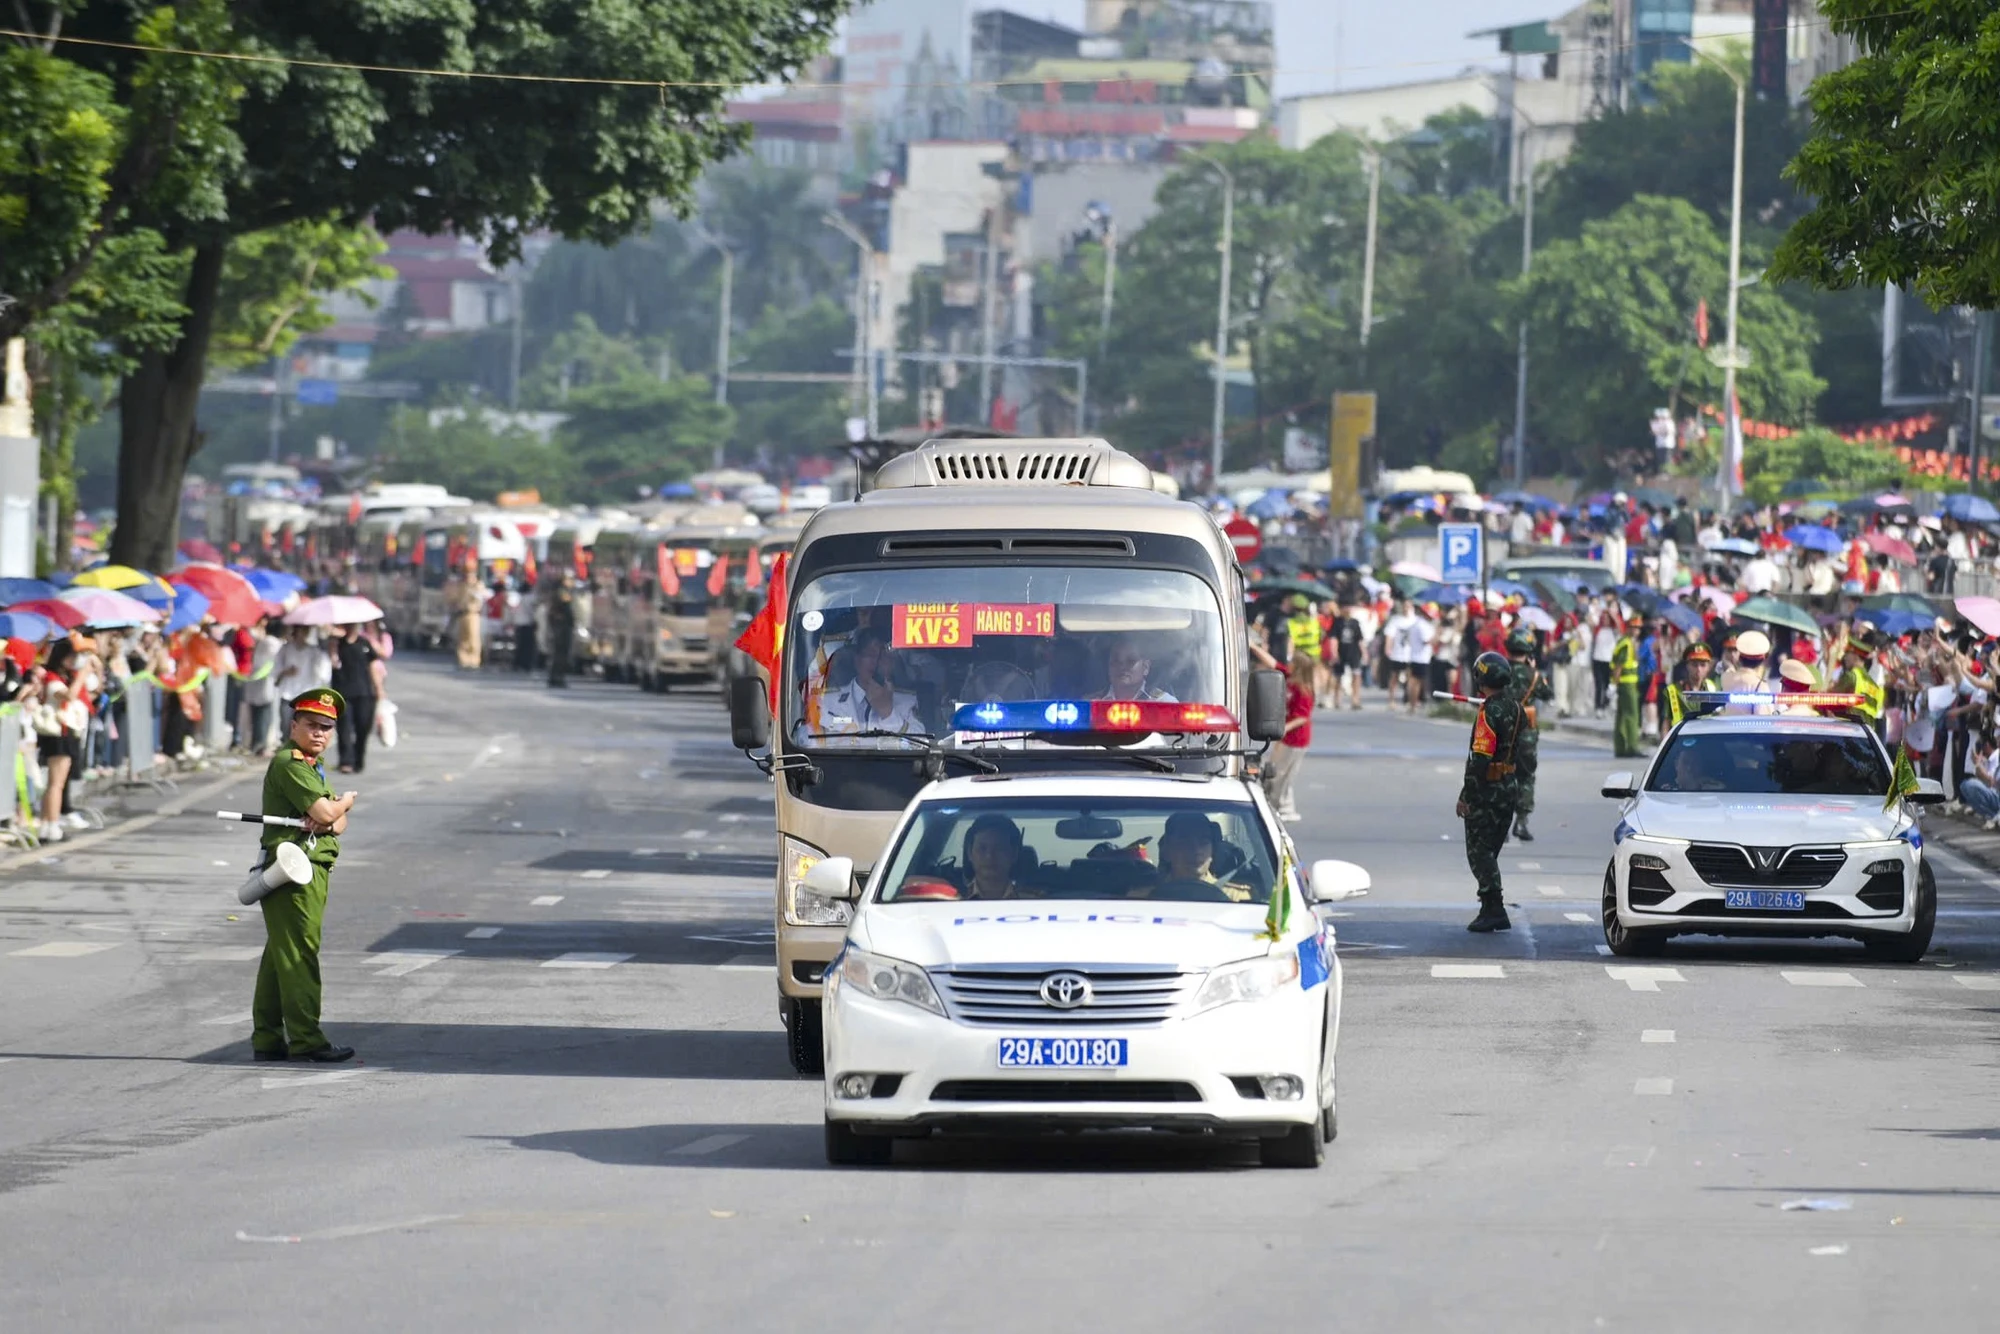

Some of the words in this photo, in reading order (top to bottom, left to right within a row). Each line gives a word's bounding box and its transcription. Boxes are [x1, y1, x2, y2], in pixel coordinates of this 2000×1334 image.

[1448, 536, 1471, 565] P
[905, 617, 960, 645] KV3
[976, 606, 1012, 633] HÀNG
[1015, 613, 1024, 633] 9
[1036, 611, 1051, 633] 16
[953, 914, 1188, 927] POLICE
[1002, 1039, 1121, 1065] 29A-001.80
